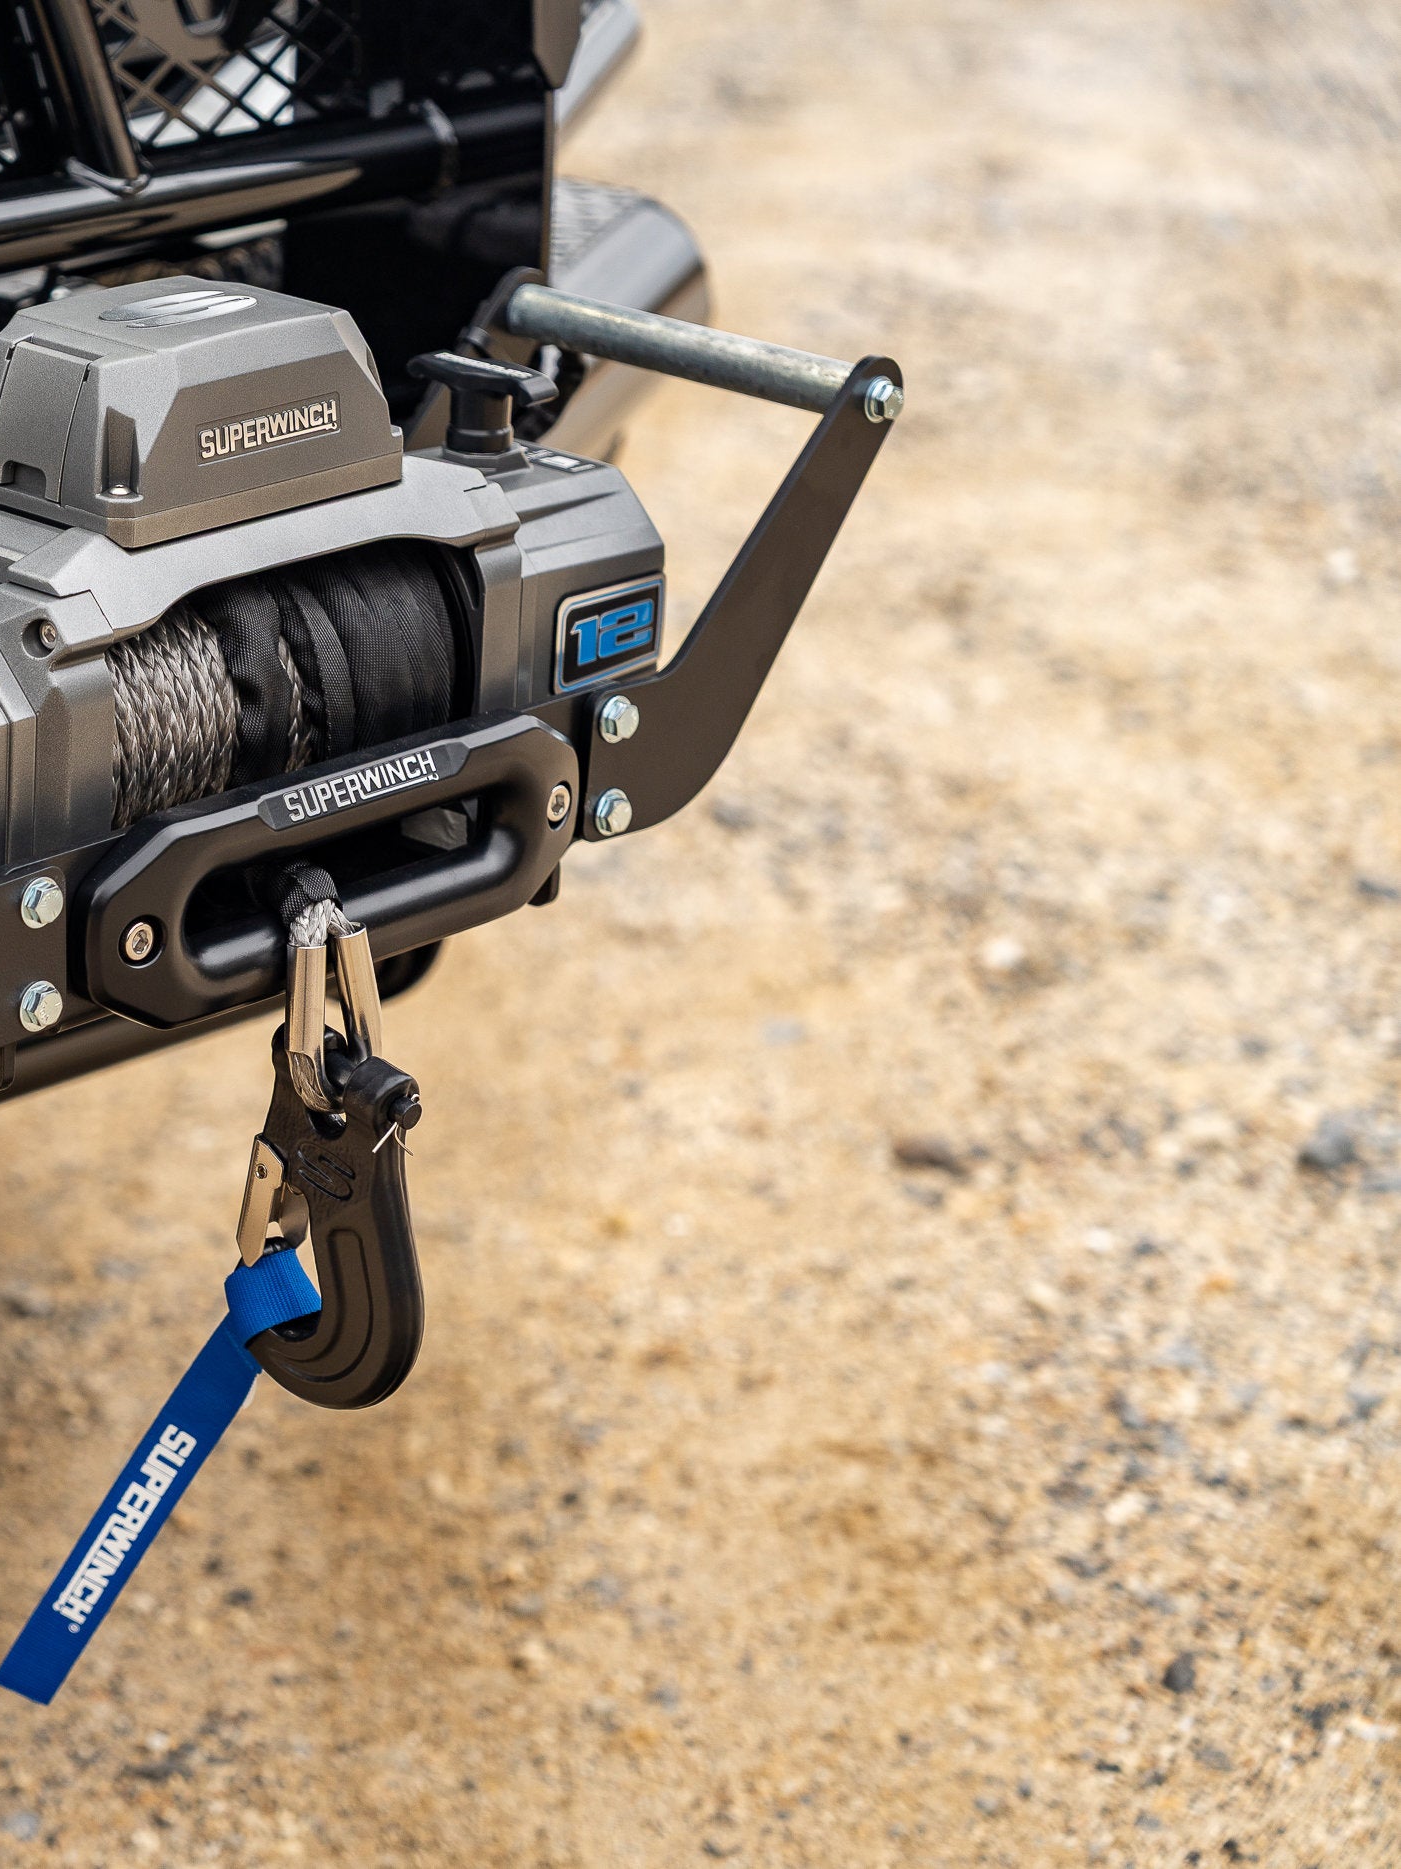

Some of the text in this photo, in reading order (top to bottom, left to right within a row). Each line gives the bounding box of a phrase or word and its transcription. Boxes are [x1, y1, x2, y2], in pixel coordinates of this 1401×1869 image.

[199, 400, 337, 459] SUPERWINCH
[569, 598, 654, 667] 12
[283, 749, 439, 822] SUPERWINCH
